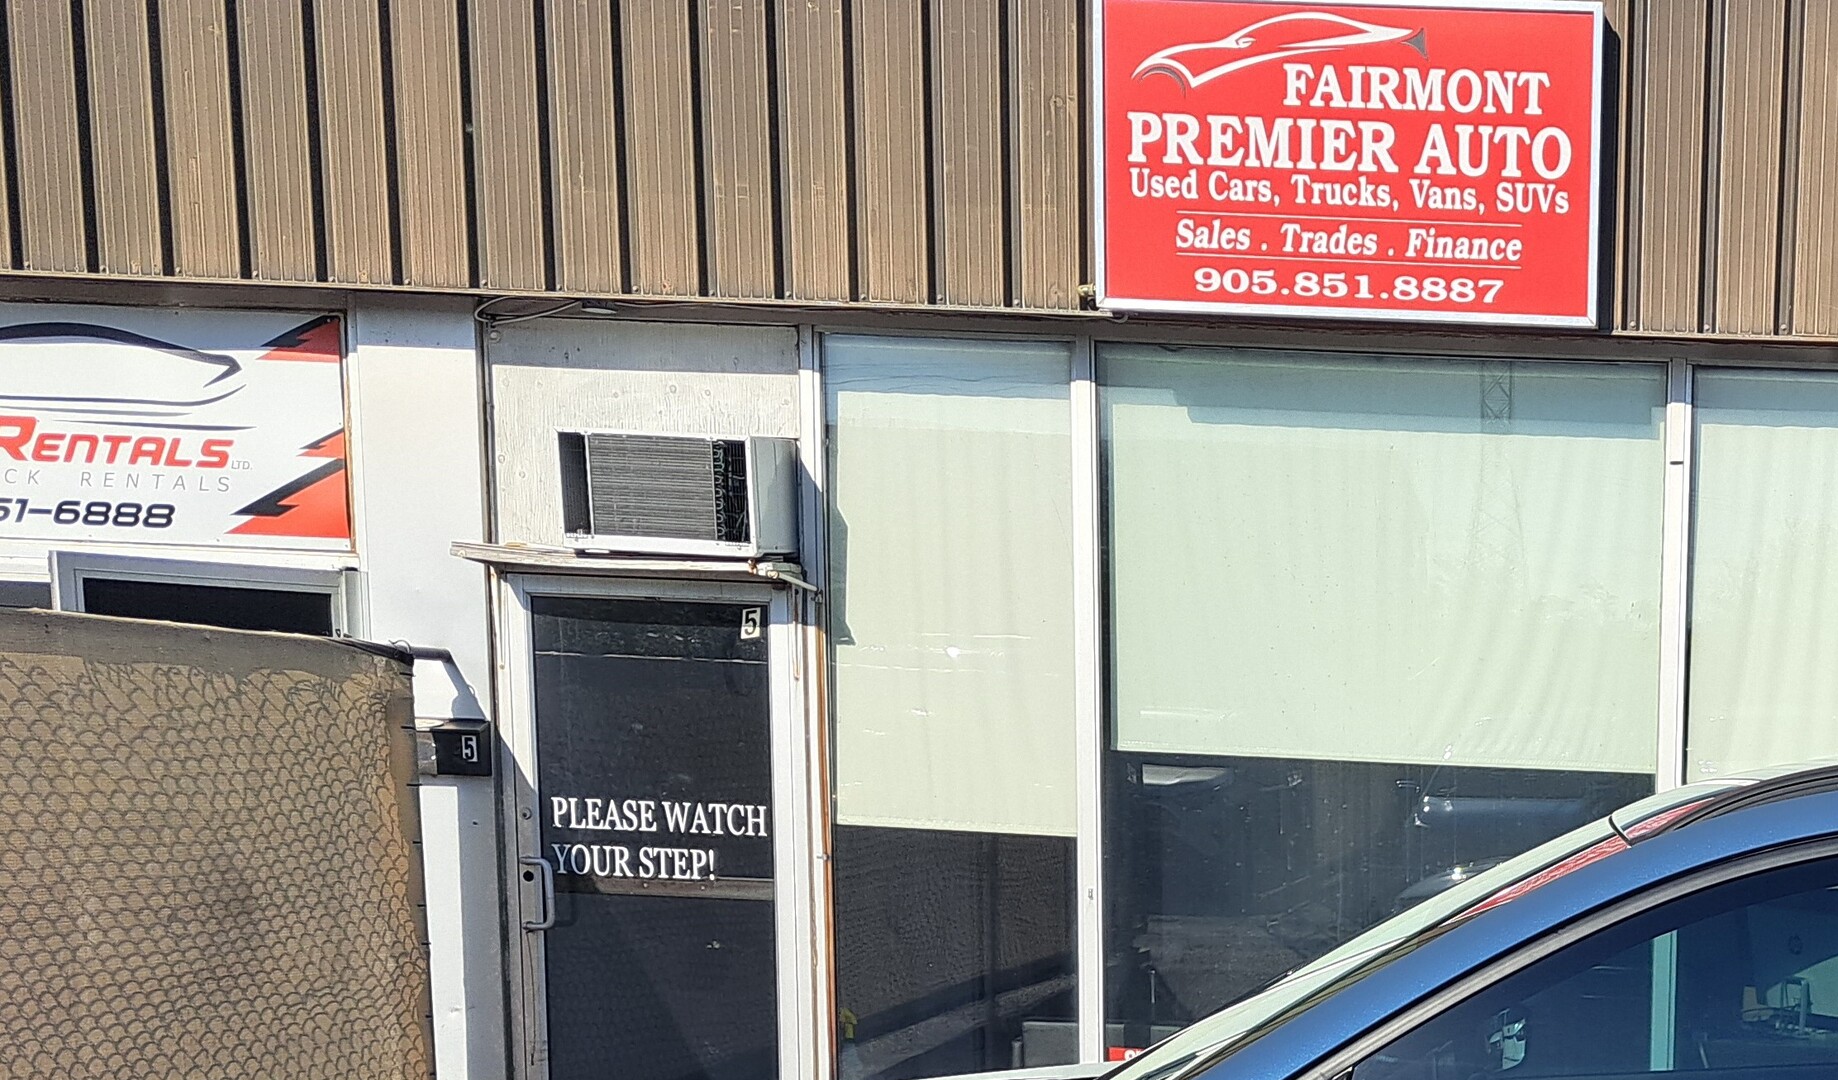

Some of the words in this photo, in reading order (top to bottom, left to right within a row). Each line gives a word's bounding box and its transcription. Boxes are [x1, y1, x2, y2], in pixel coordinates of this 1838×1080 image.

[1283, 63, 1550, 115] FAIRMONT
[1127, 111, 1399, 173] PREMIER
[1413, 123, 1572, 180] AUTO
[1129, 167, 1199, 200] Used
[1208, 170, 1280, 208] Cars,
[1290, 174, 1399, 212] Trucks,
[1408, 178, 1485, 216] Vans,
[1496, 181, 1570, 214] SUVs
[1175, 218, 1251, 251] Sales
[1280, 222, 1378, 255] Trades
[1404, 227, 1523, 262] Finance
[1193, 267, 1504, 304] 905.851.8887
[80, 471, 231, 493] RENTALS
[744, 609, 758, 636] 5
[550, 796, 657, 832] PLEASE
[661, 801, 768, 837] WATCH
[551, 843, 634, 878] YOUR
[638, 846, 715, 881] STEP!
